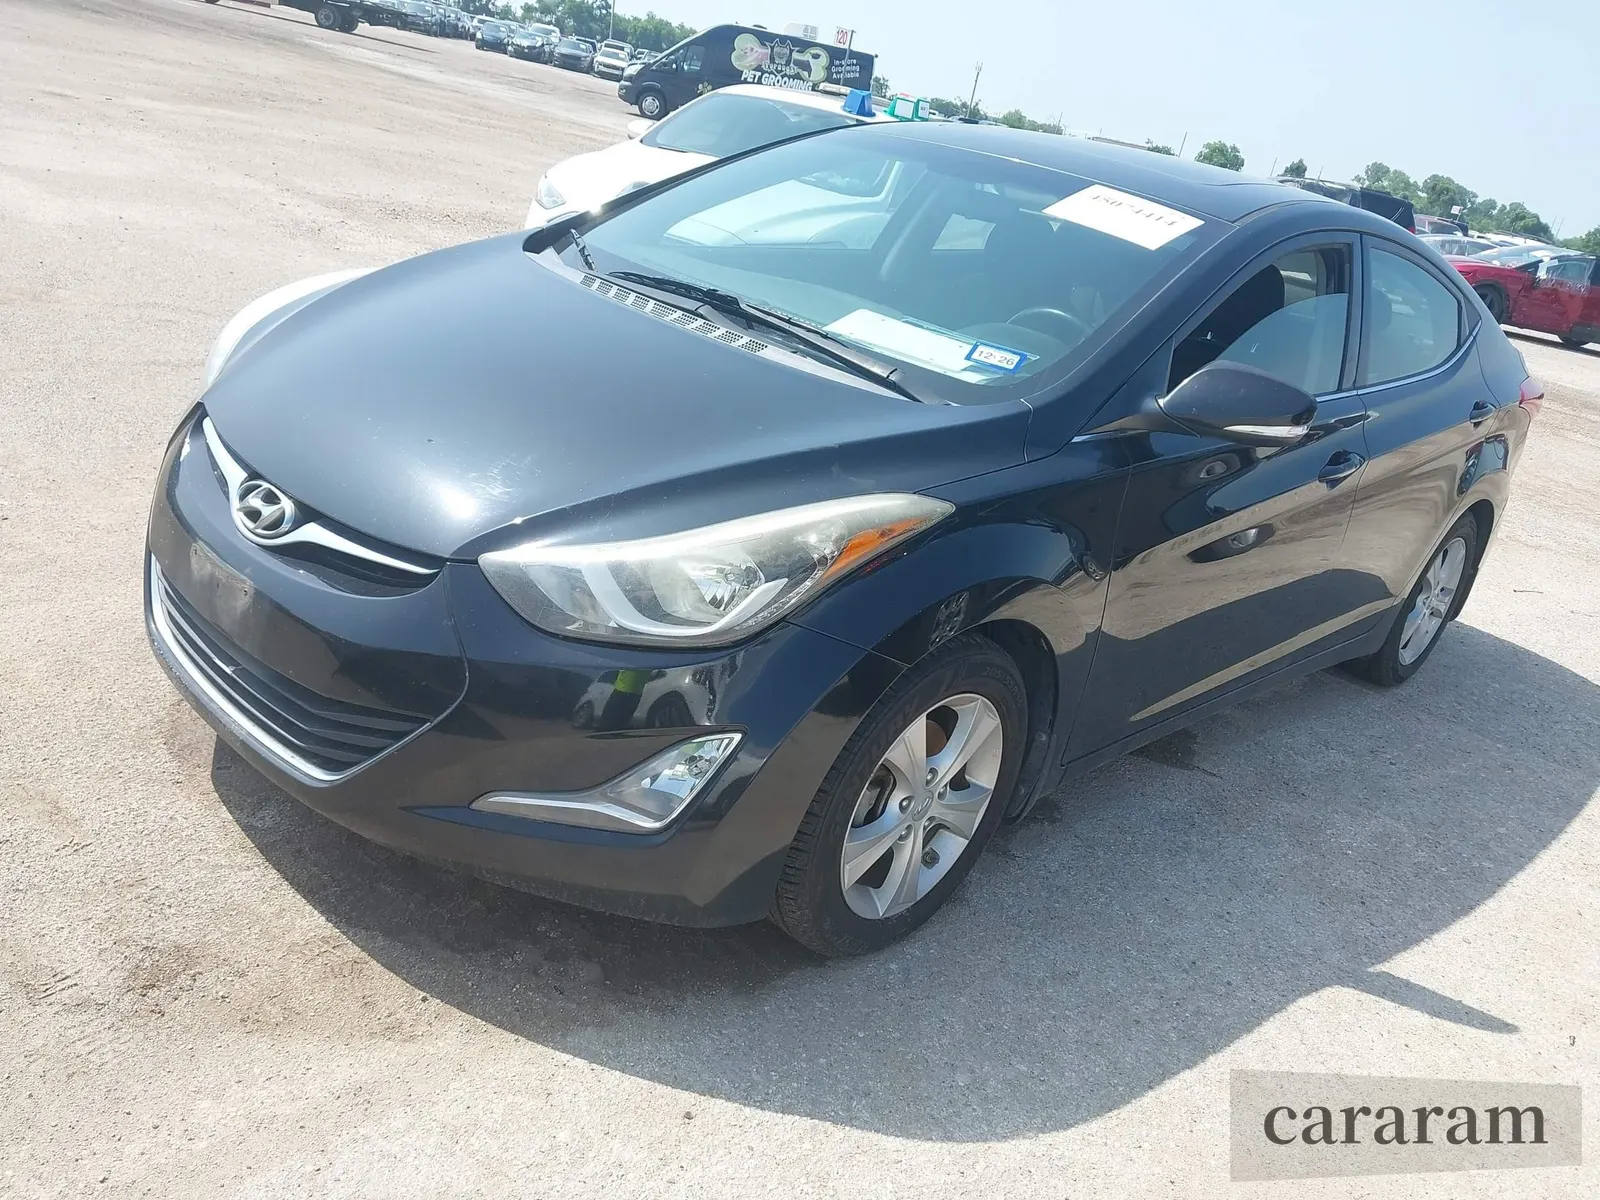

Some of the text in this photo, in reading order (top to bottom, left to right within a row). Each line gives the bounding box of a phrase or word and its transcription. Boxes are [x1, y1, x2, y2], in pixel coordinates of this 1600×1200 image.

[836, 29, 848, 45] 120
[833, 58, 857, 66] In-sore
[741, 69, 813, 91] PET GROOMING
[832, 71, 860, 80] Avalable
